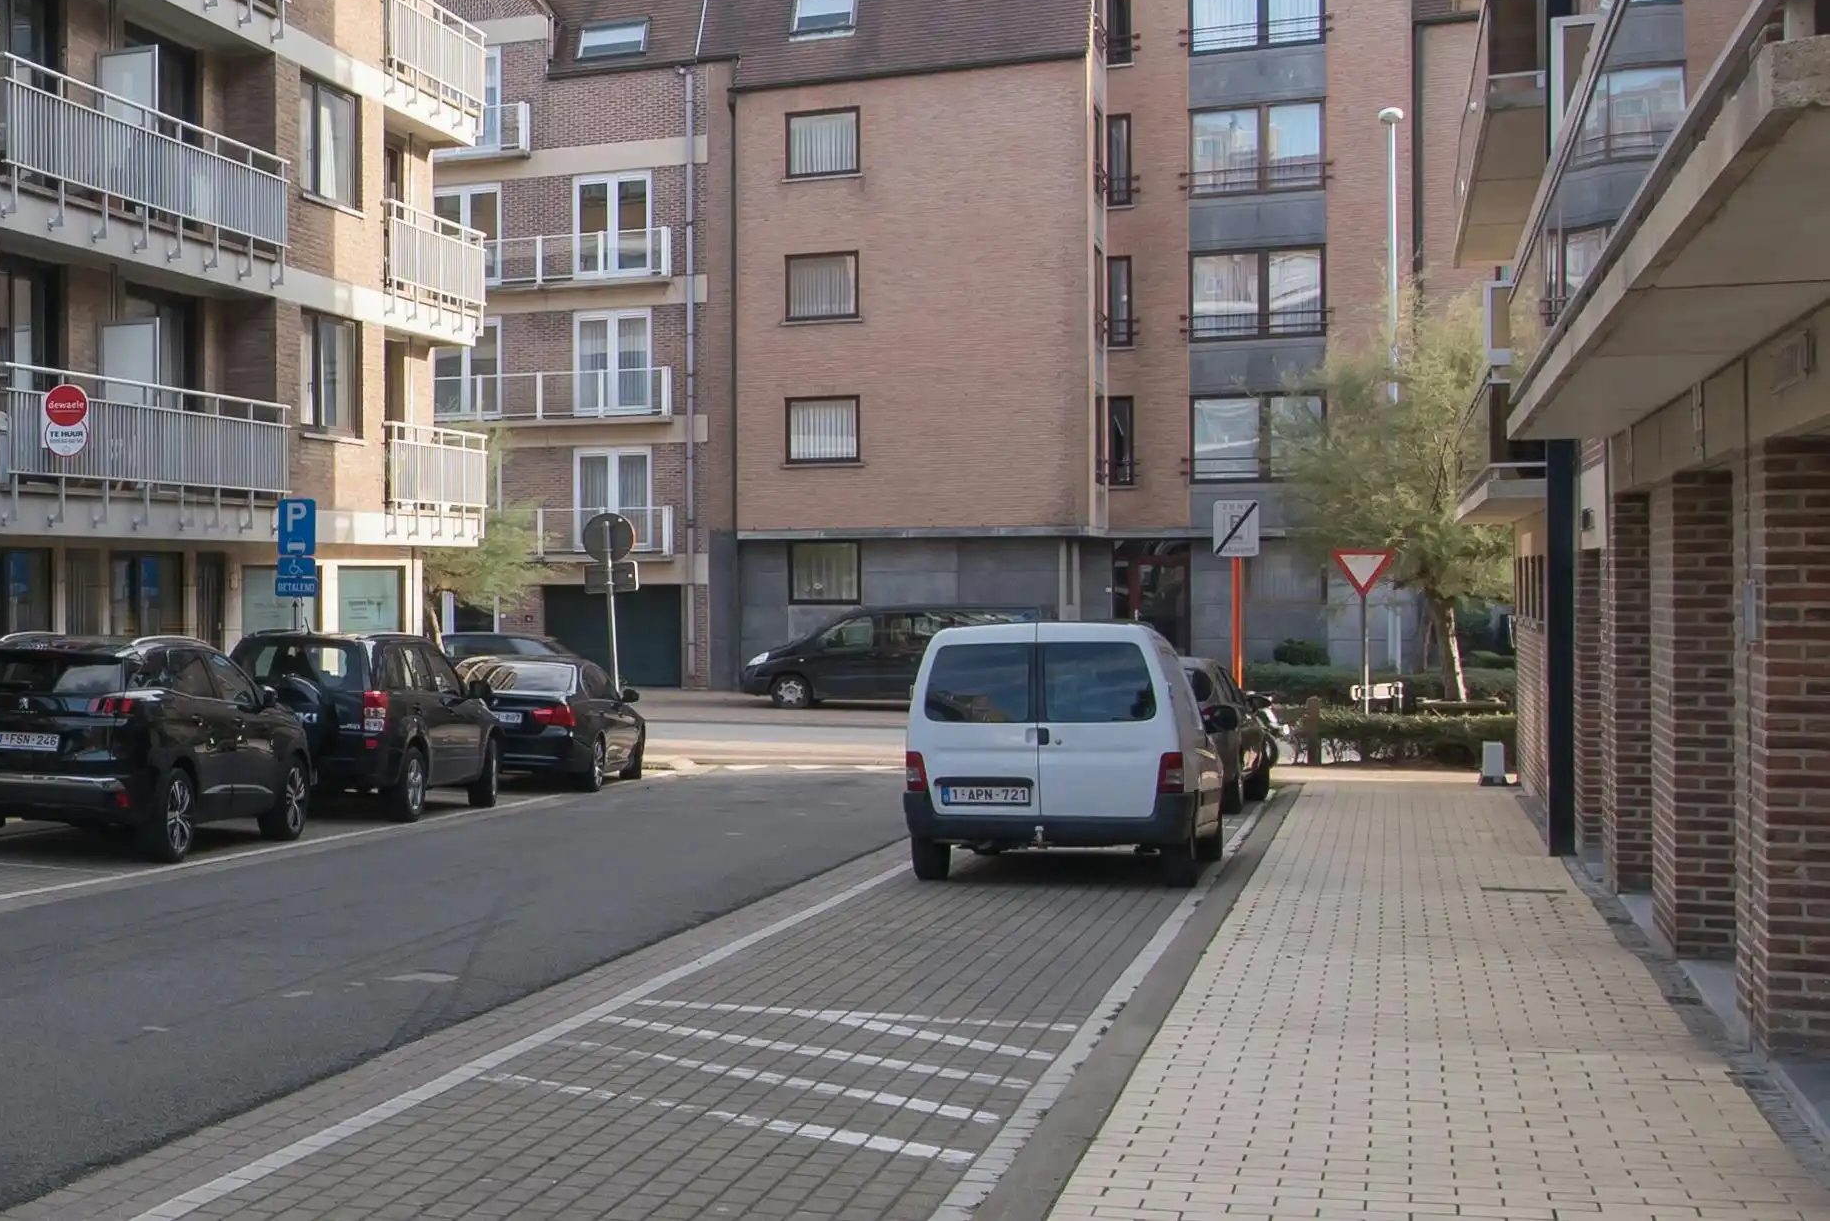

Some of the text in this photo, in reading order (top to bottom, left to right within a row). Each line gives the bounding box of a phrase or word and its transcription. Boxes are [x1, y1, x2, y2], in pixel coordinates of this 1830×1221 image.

[48, 400, 85, 409] dewaele
[50, 430, 83, 438] TE HUUR
[287, 502, 307, 532] P
[952, 788, 1028, 800] 1-APN-721
